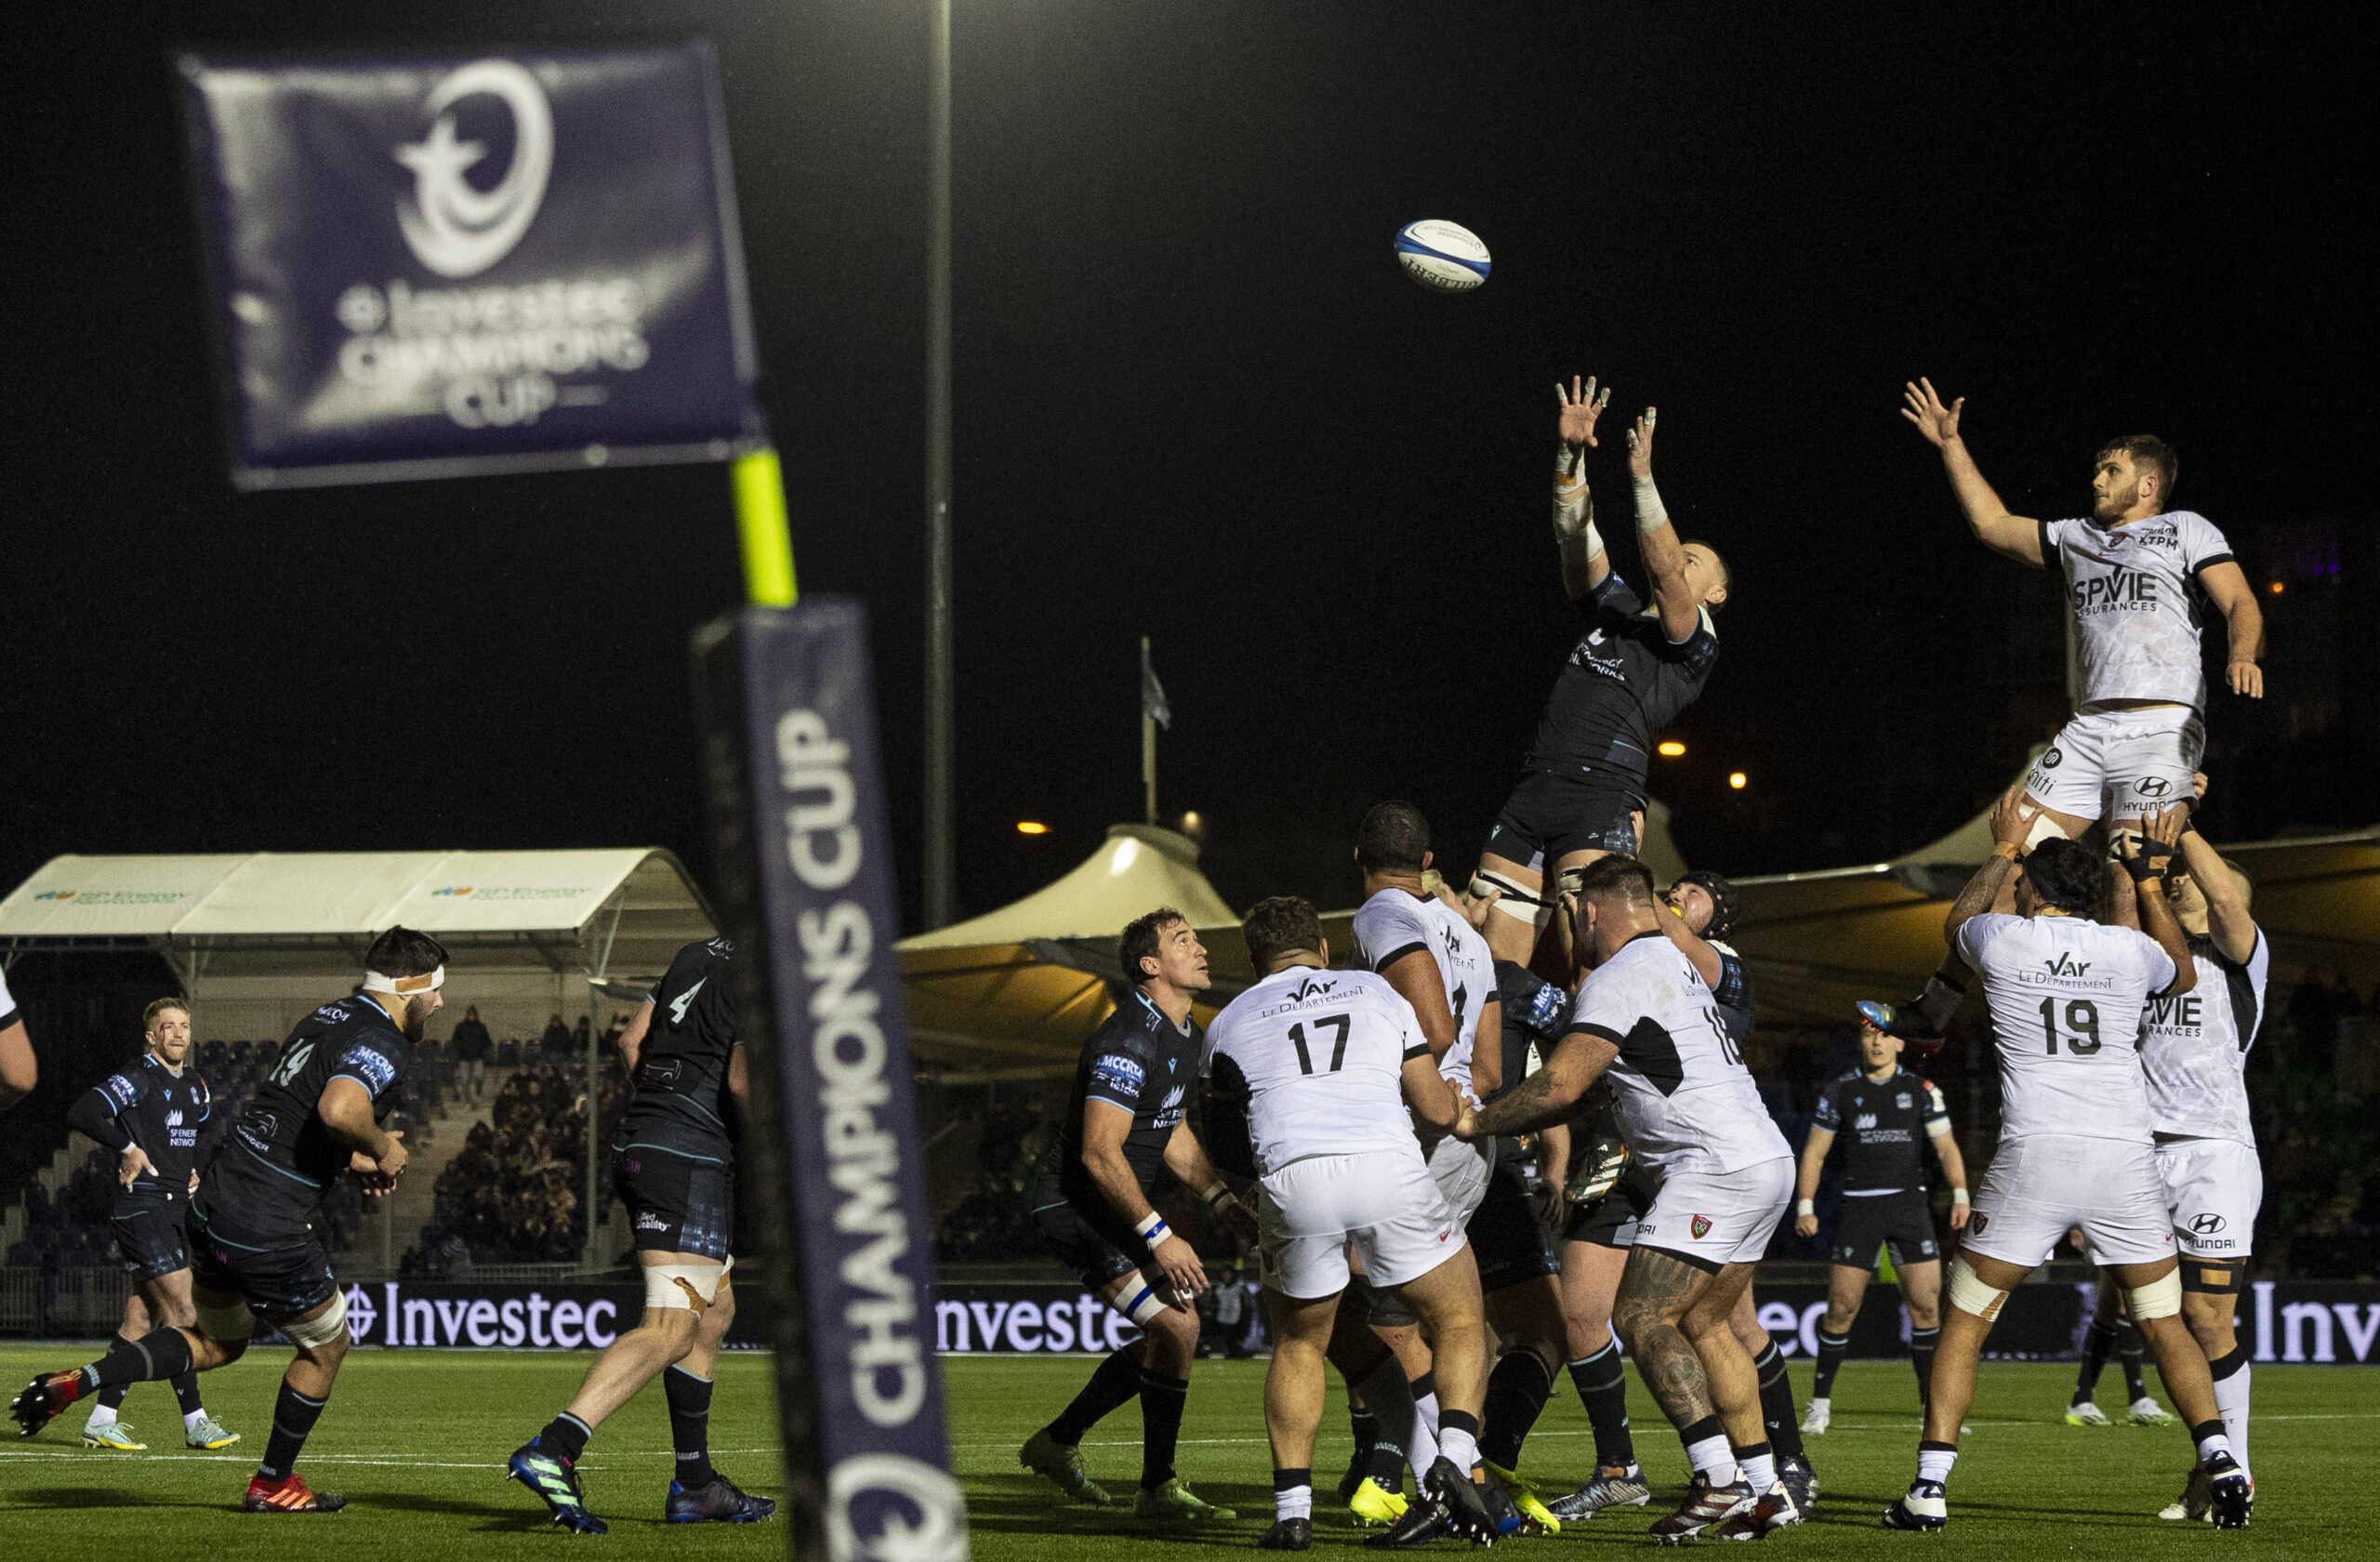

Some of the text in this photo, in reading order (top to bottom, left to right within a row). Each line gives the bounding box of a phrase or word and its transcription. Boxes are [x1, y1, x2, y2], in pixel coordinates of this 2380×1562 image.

[1405, 258, 1479, 289] GILBERT
[2074, 564, 2157, 610] SPVIE
[2078, 602, 2157, 618] SSURANCES
[669, 976, 707, 1024] 4
[1288, 1013, 1350, 1075] 17
[2039, 997, 2101, 1055] 19
[357, 1045, 395, 1081] MCCREA
[776, 708, 927, 1426] CHAMPIONS CUP
[170, 1129, 178, 1137] SP
[170, 1138, 195, 1147] NETWO
[385, 1282, 617, 1348] Investec
[935, 1293, 1144, 1352] nveste
